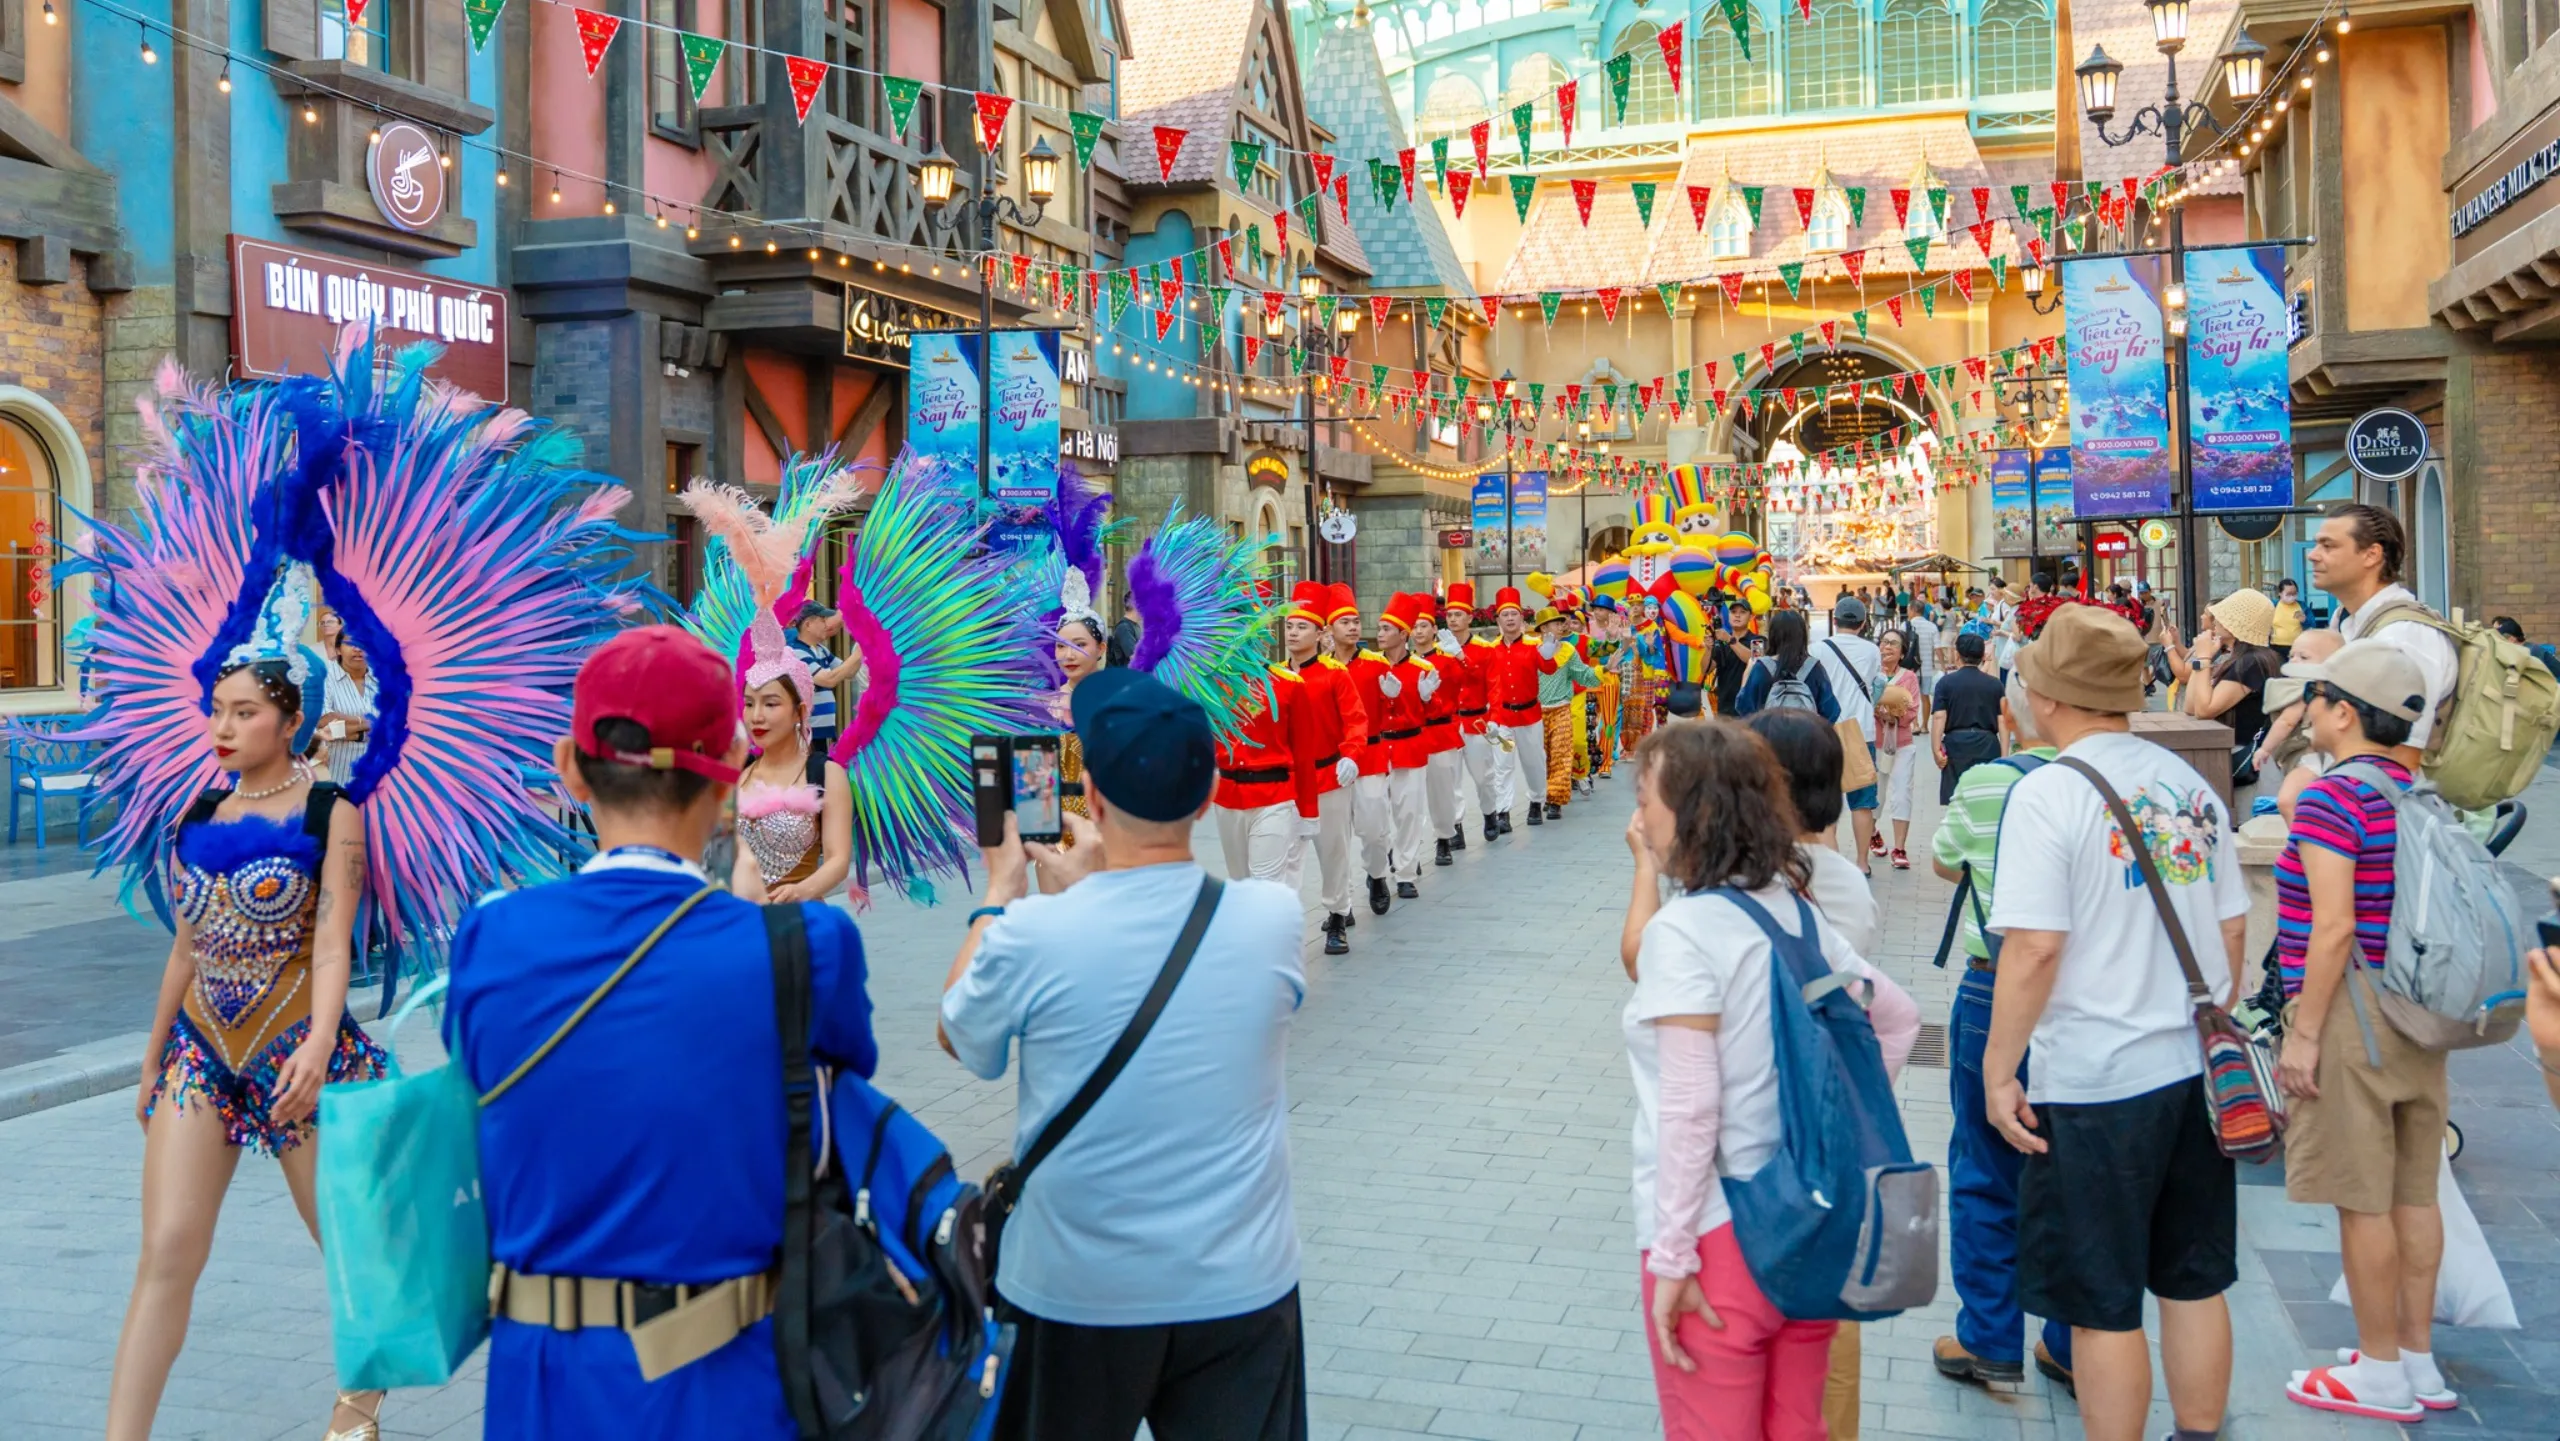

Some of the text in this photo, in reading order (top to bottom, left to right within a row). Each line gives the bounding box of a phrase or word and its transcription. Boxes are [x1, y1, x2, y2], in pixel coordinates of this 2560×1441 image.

[2450, 176, 2506, 239] TAIWANESE
[2507, 152, 2538, 200] MILK
[265, 257, 319, 315] BÚN
[324, 272, 386, 325] QUÂY
[389, 285, 435, 335] PHÚ
[437, 292, 493, 344] QUỐC
[2217, 434, 2254, 443] 300.000
[1076, 430, 1094, 459] Hà
[1098, 432, 1119, 467] Nội
[2097, 440, 2132, 449] 300.000
[2390, 446, 2419, 456] TEA
[2099, 491, 2121, 499] 0942
[2137, 490, 2151, 498] 212
